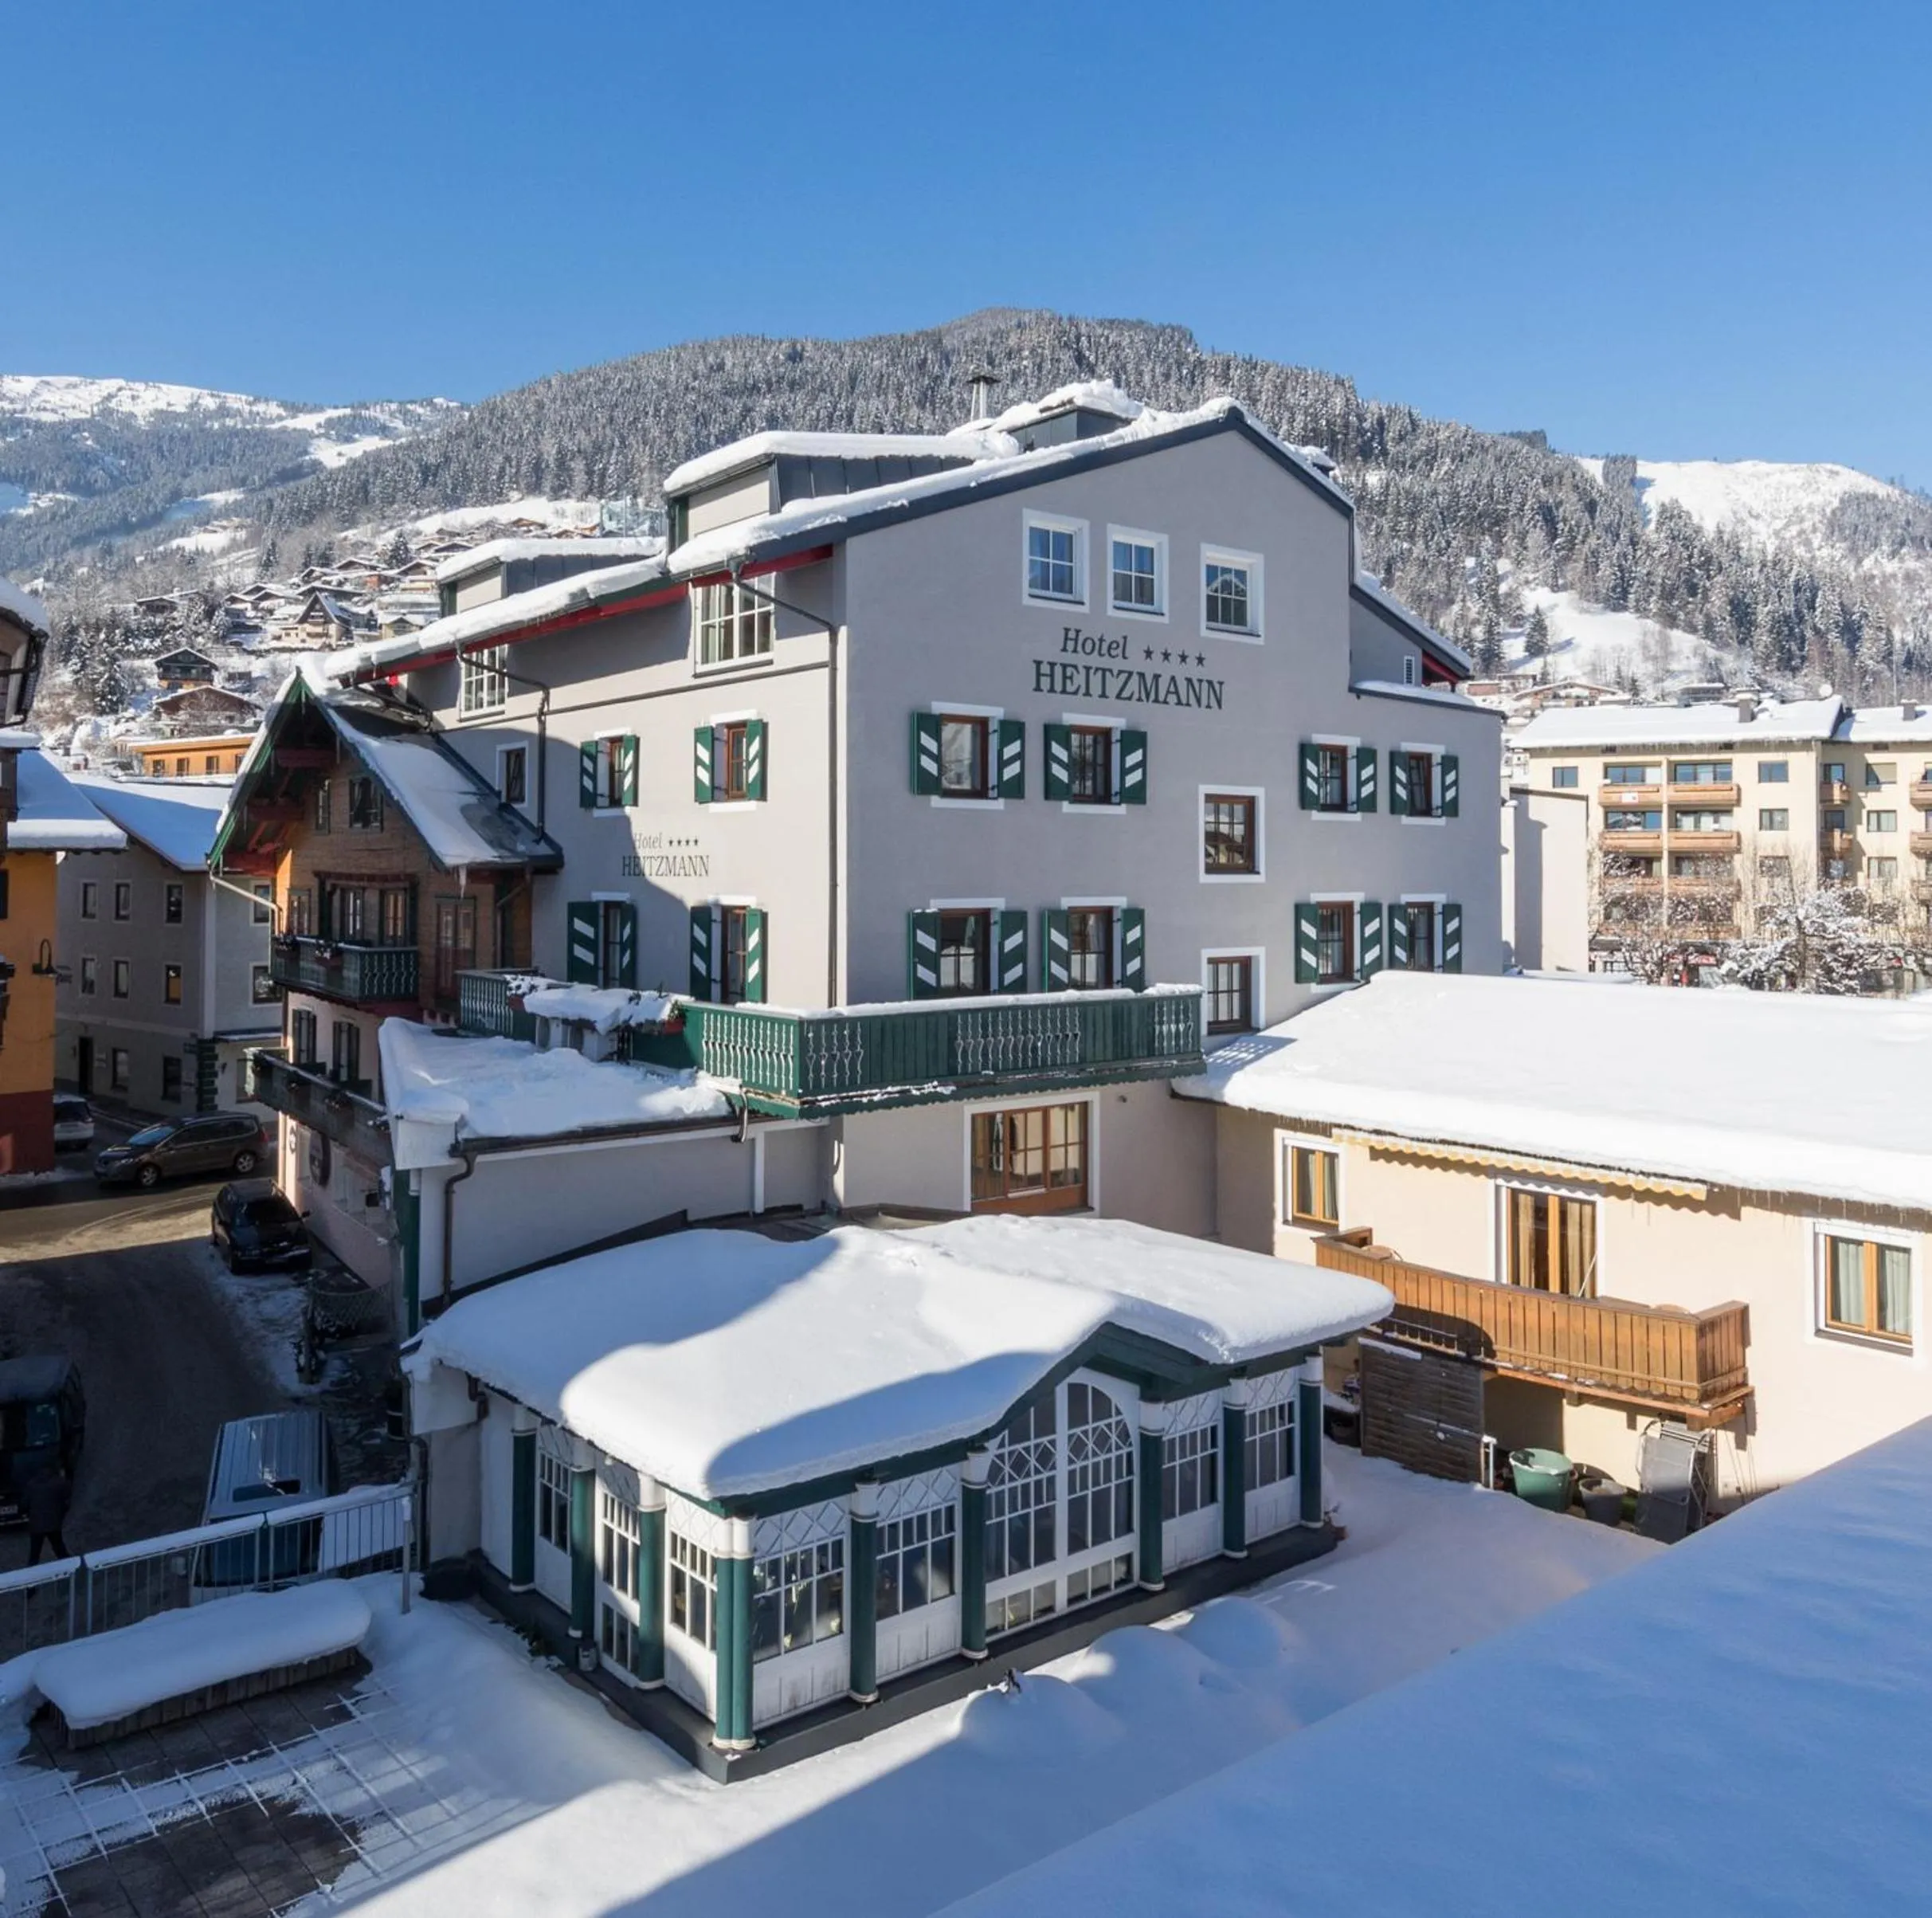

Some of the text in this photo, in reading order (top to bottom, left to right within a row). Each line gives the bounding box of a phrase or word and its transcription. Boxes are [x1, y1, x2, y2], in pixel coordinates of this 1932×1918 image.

[1060, 626, 1129, 661] Hotel
[1032, 659, 1225, 710] HEITZMANN
[633, 832, 663, 849] Hotel
[621, 854, 709, 877] HEITZMANN
